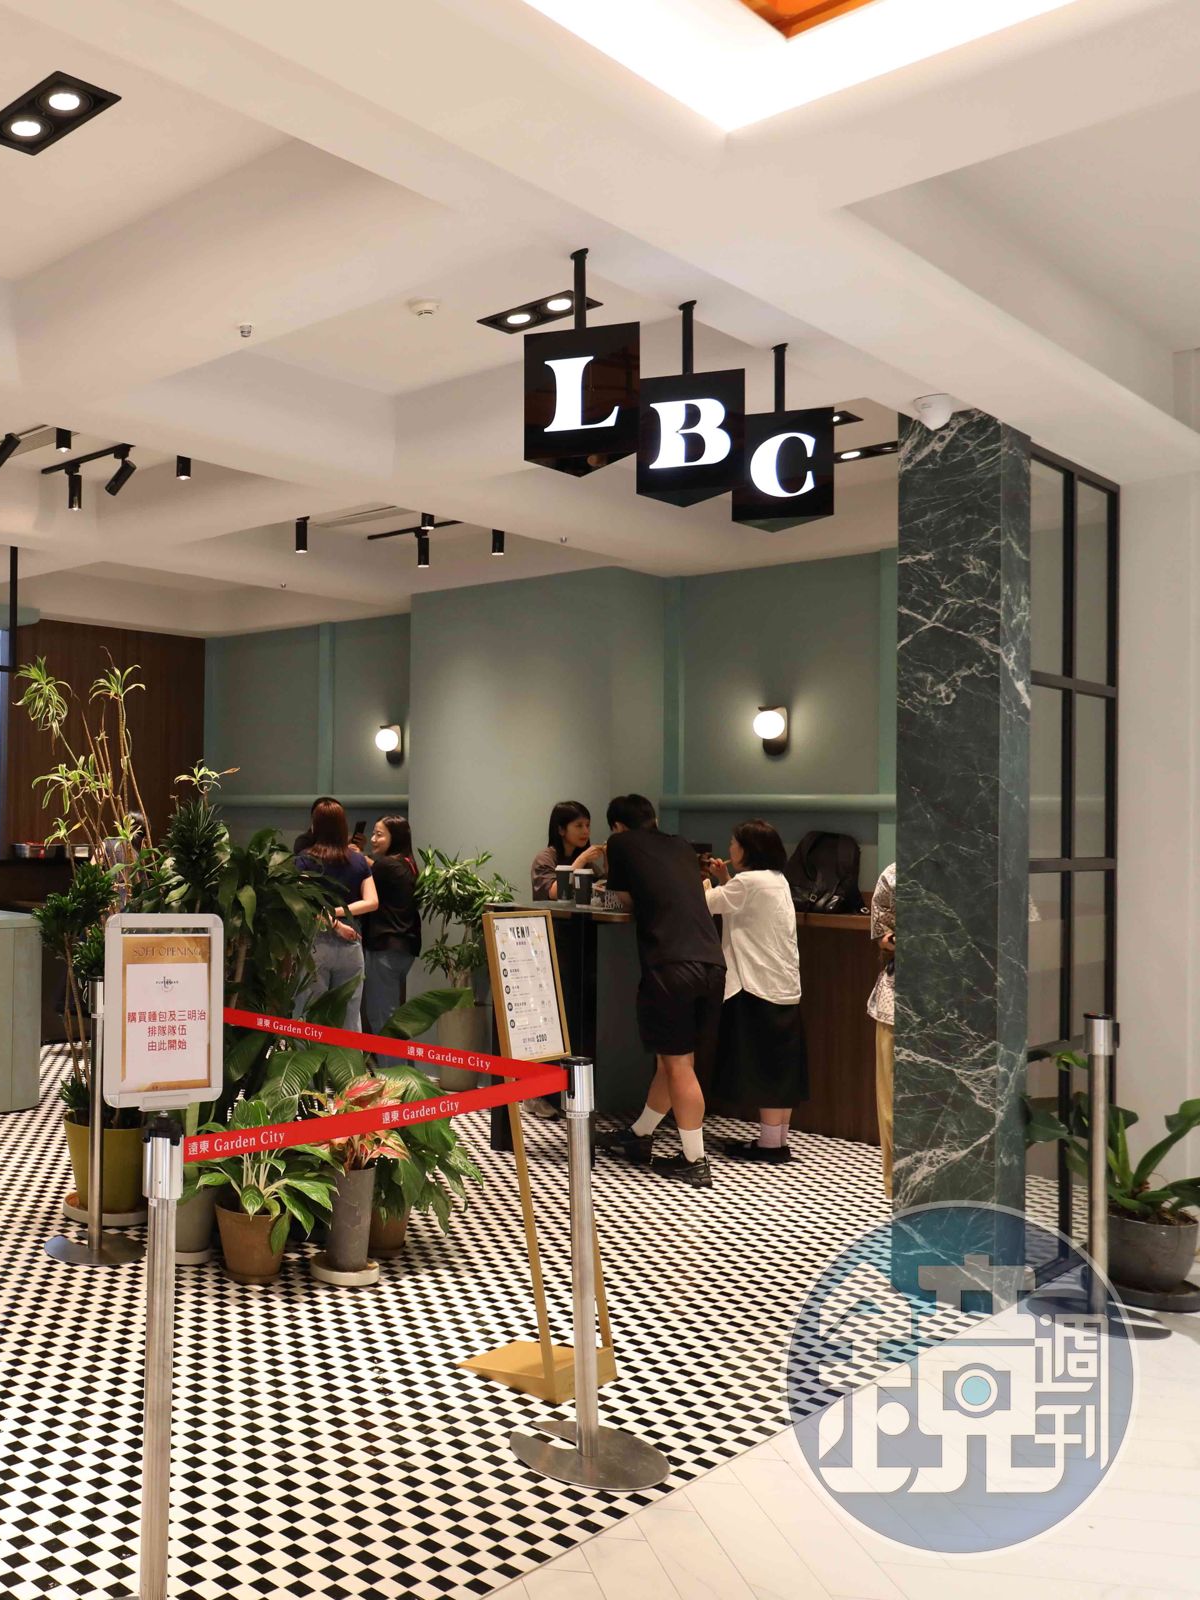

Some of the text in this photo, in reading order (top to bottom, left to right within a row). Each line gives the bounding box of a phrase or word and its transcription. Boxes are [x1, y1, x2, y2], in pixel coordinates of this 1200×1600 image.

[133, 946, 202, 957] SOFT OPENING
[127, 1009, 207, 1023] 購買麵包及三明治
[147, 1024, 187, 1037] 排隊隊伍
[272, 1020, 302, 1034] Garden
[304, 1026, 323, 1040] City
[147, 1038, 187, 1052] 由此開始
[427, 1049, 464, 1064] Garden
[467, 1056, 491, 1071] City
[402, 1105, 436, 1120] Garden
[439, 1100, 460, 1113] City
[188, 1131, 285, 1156] 遠東 Garden City
